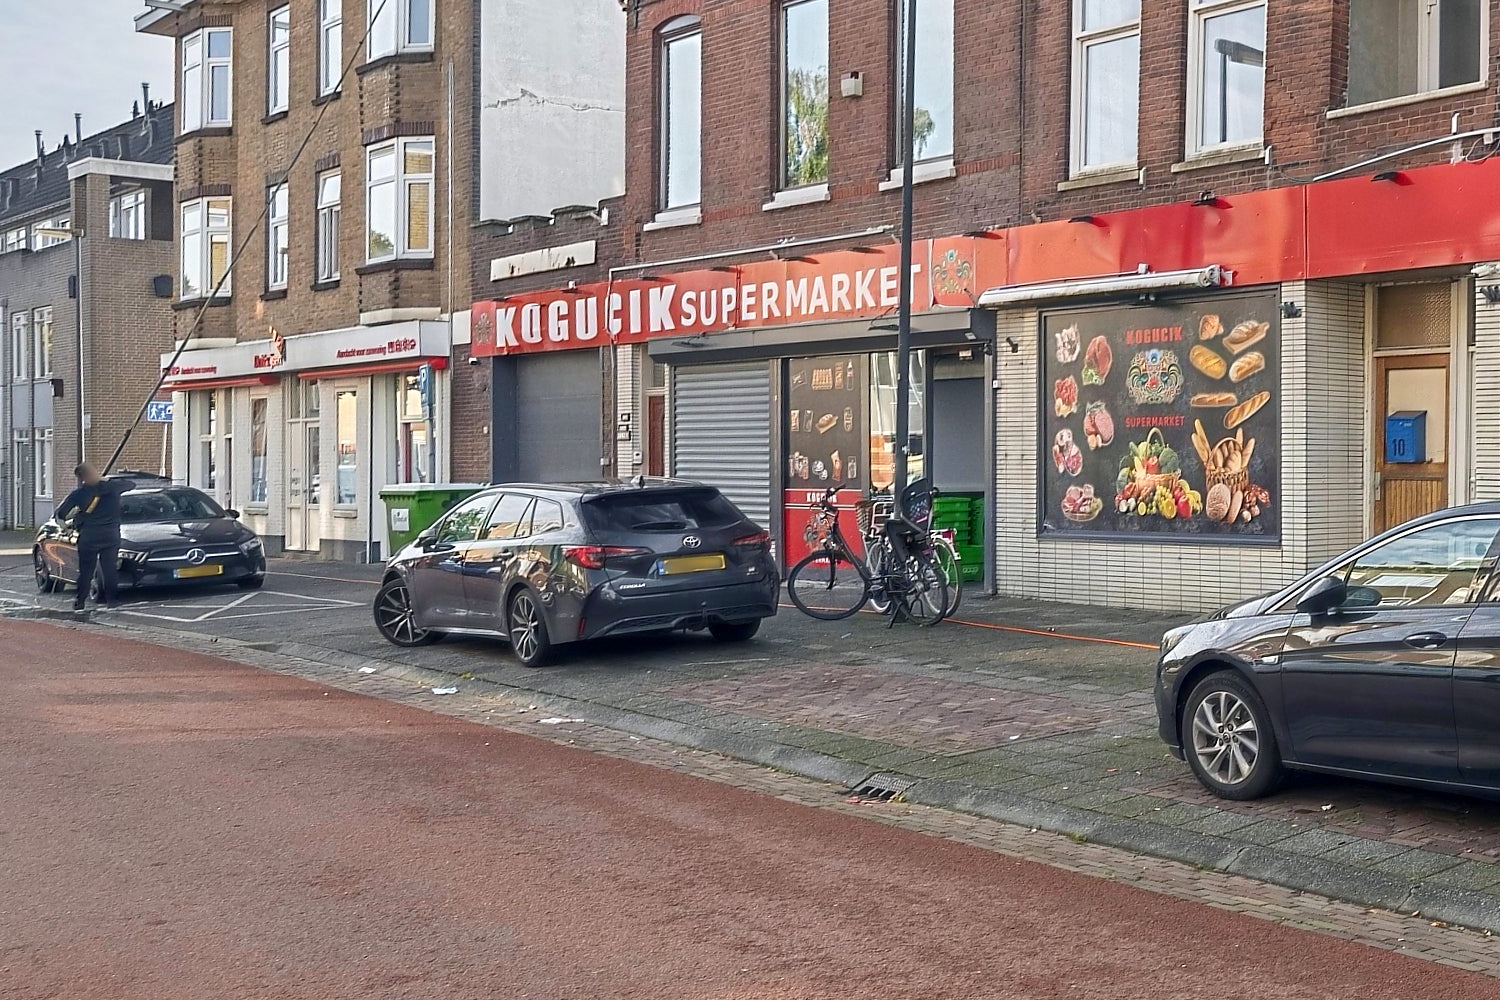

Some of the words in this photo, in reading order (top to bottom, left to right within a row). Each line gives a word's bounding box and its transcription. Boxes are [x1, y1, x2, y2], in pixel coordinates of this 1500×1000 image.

[496, 284, 676, 347] KOGUCIK
[680, 263, 922, 327] SUPERMARKET
[1126, 325, 1183, 345] KOGUCIK
[1125, 415, 1185, 428] SUPERMARKET
[1392, 438, 1405, 456] 10
